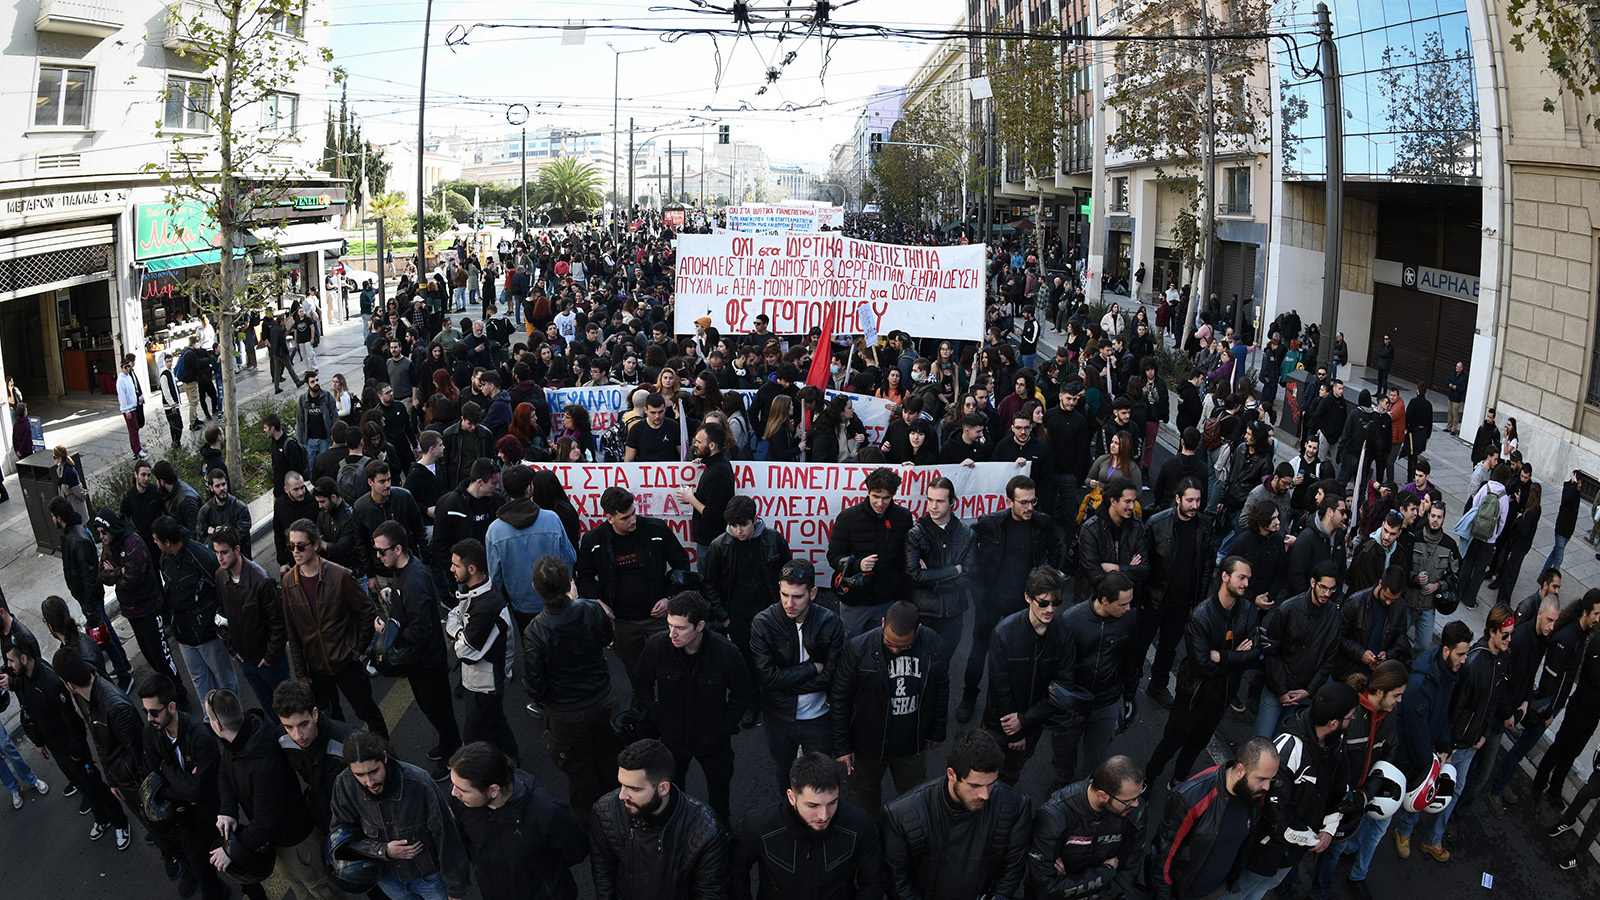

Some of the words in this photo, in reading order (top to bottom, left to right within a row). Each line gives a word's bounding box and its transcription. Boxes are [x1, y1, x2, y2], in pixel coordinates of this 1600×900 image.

[6, 196, 54, 213] ΜΕΓΑΡΟΝ
[62, 192, 111, 206] ΠΑΛΛΑΔΣ
[732, 236, 753, 256] ΟΧΙ
[758, 246, 781, 256] στα
[786, 236, 843, 258] ΙΔΙΩΤΙΚΑ
[850, 240, 940, 269] ΠΑΝΕΠΙΣΤΗΜΙΑ
[679, 255, 765, 276] ΑΠΟΚΛΕΙΣΤΙΚΑ
[770, 258, 819, 277] ΔΗΜΟΣΙΑ
[823, 258, 835, 278] &
[838, 259, 882, 281] ΔΩΡΕΑΝ
[910, 268, 979, 289] ΕΚΠΑΙΔΕΥΣΗ
[1421, 271, 1469, 295] ALPHA
[675, 276, 712, 294] ΠΤΥΧΙΑ
[716, 283, 729, 296] με
[870, 288, 888, 300] για
[891, 284, 937, 303] ΔΟΥΛΕΙΑ
[762, 298, 888, 334] ΓΕΩΠΟΝΙΚΟΥ
[582, 466, 629, 489] ΣΤΑ
[753, 495, 829, 517] ΟΥΛΕΙΑ
[1064, 876, 1103, 898] FLM
